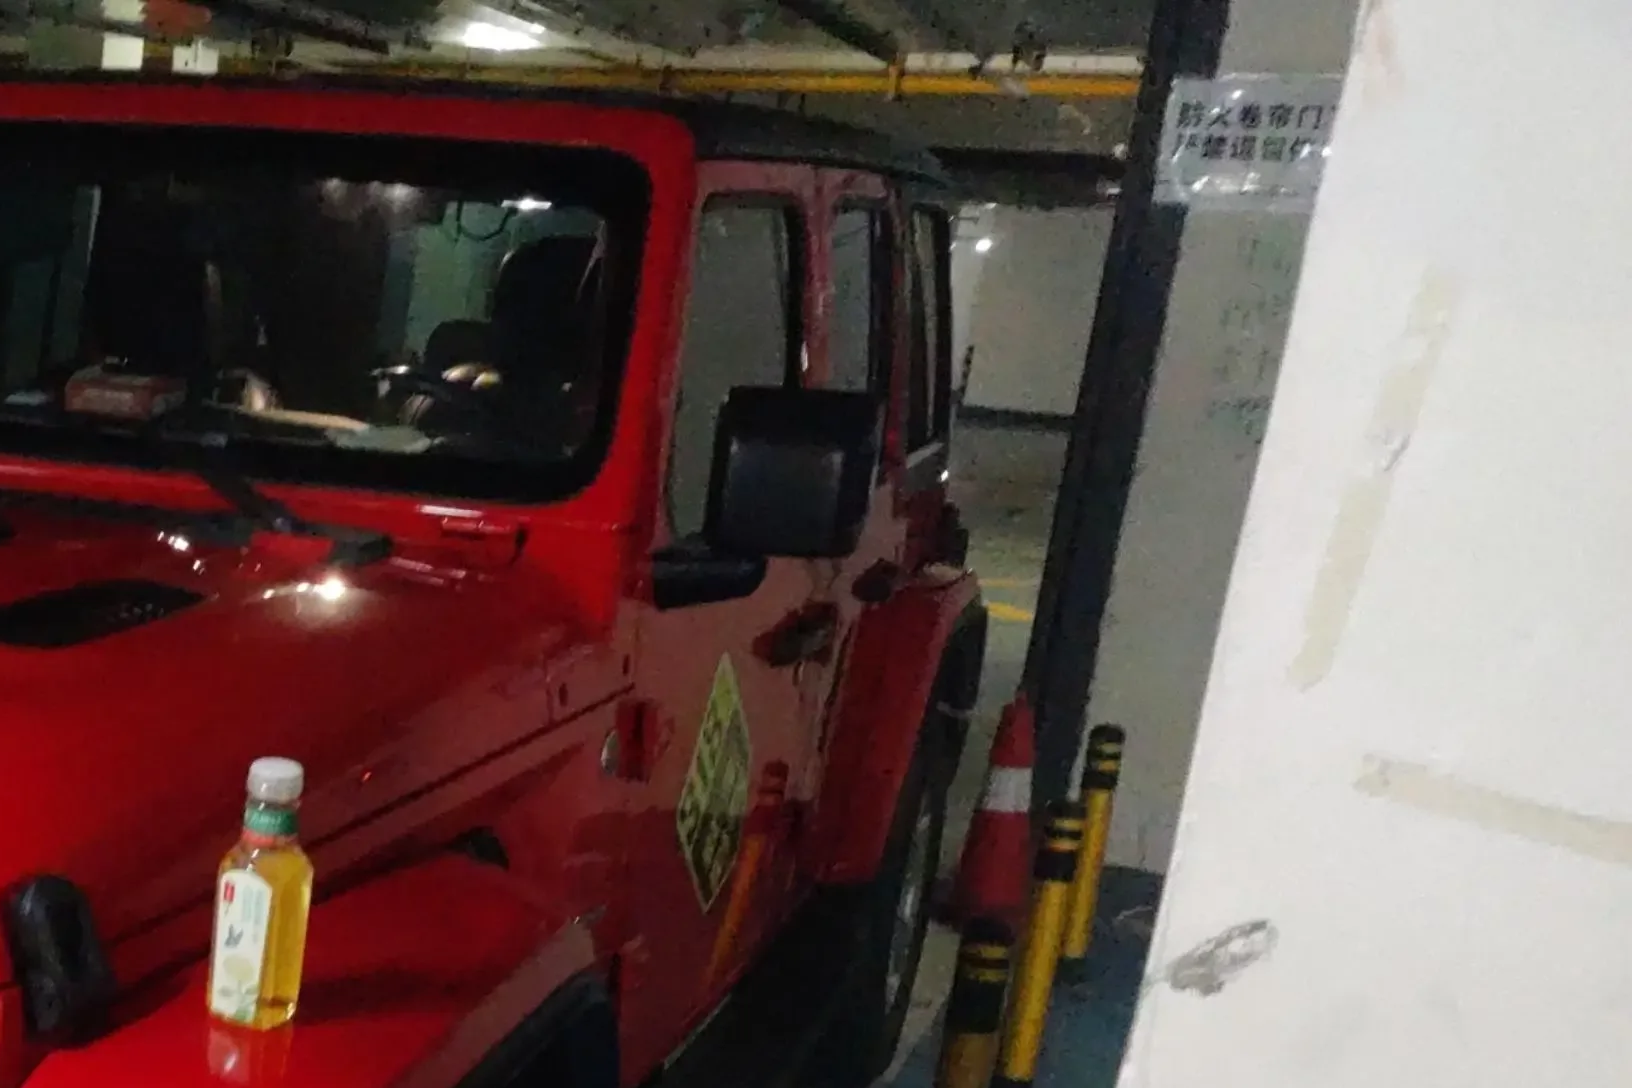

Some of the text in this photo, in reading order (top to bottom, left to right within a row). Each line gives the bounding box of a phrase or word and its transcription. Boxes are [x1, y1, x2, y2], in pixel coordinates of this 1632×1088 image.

[1176, 101, 1337, 130] 防火卷帘门
